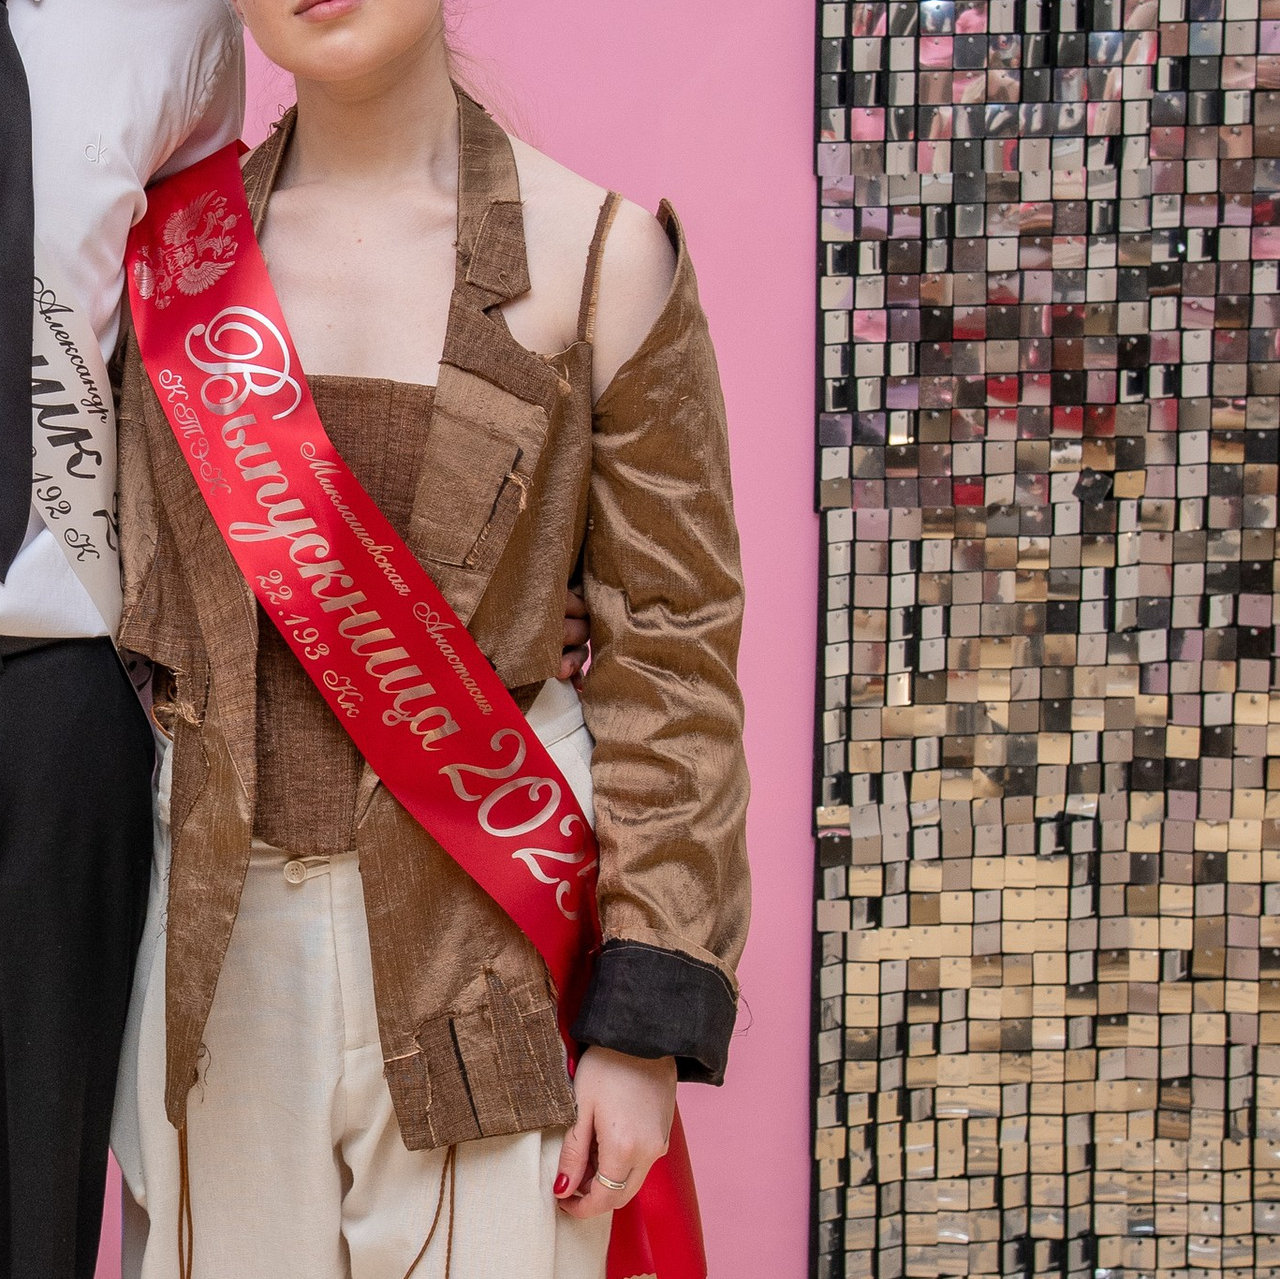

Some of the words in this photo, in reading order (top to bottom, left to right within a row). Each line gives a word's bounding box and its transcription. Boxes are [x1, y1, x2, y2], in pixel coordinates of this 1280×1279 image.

[64, 528, 100, 561] К
[158, 369, 232, 495] КТЭК
[256, 570, 331, 660] 22.193
[185, 306, 461, 752] Выпускница
[300, 442, 412, 596] Миклашевская
[413, 602, 494, 716] Анастасия
